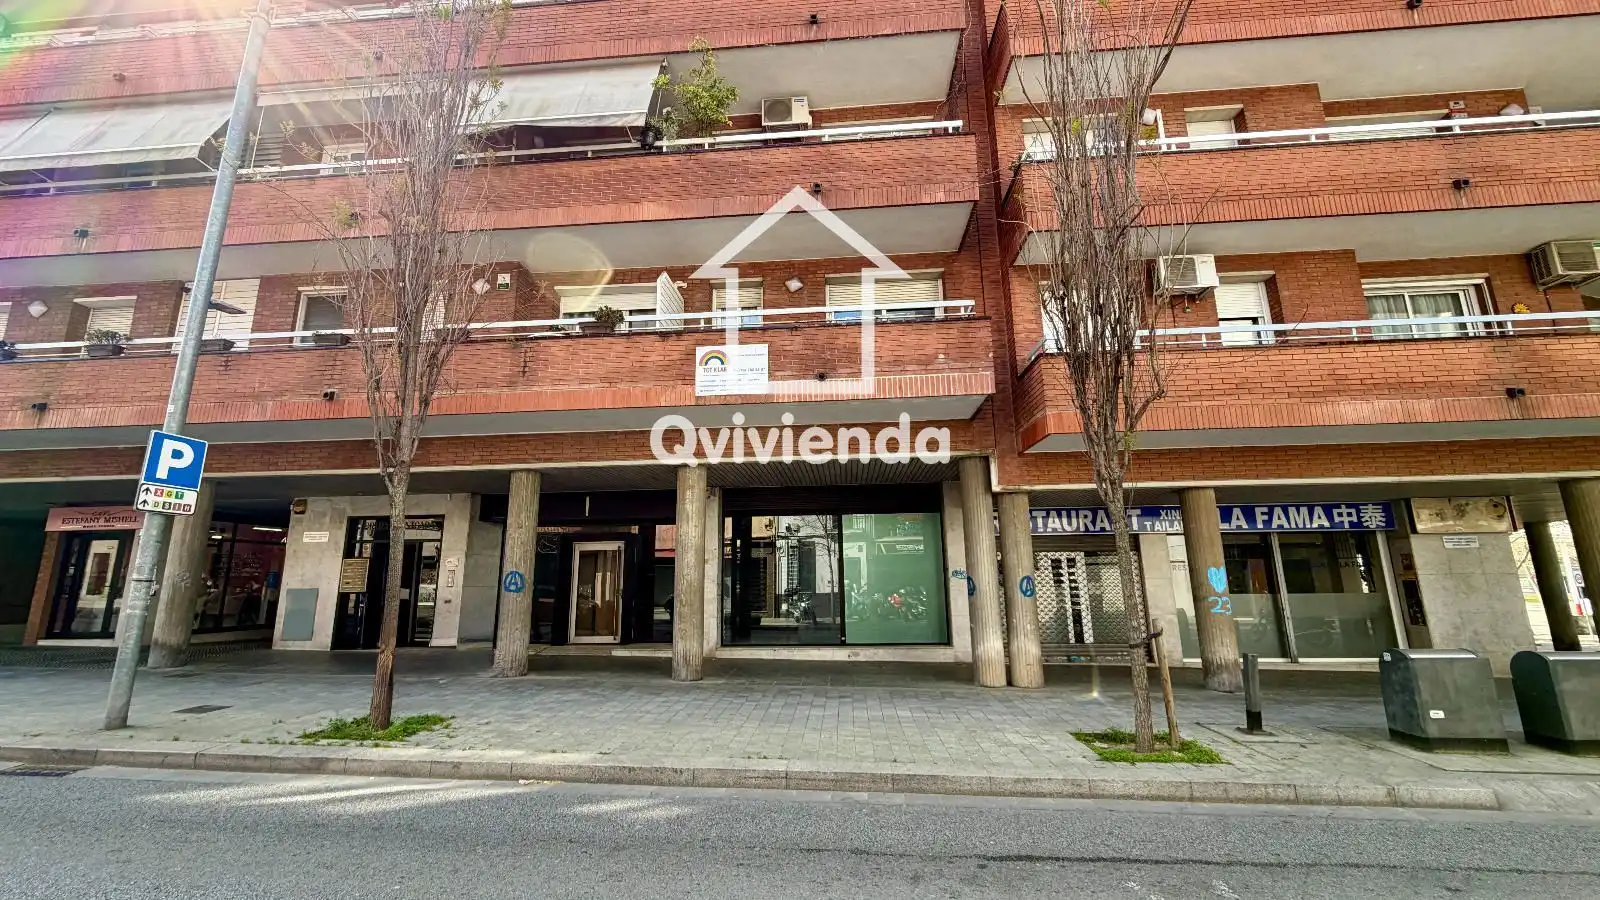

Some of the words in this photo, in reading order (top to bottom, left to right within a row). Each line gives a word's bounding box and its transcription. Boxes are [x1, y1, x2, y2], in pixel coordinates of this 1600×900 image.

[156, 438, 194, 479] P
[993, 508, 1141, 533] TAURAT
[1144, 520, 1184, 532] TAILA
[1160, 509, 1182, 520] XIN
[1216, 506, 1249, 529] LA
[1255, 505, 1331, 529] FAMA
[1332, 503, 1387, 529] 中泰
